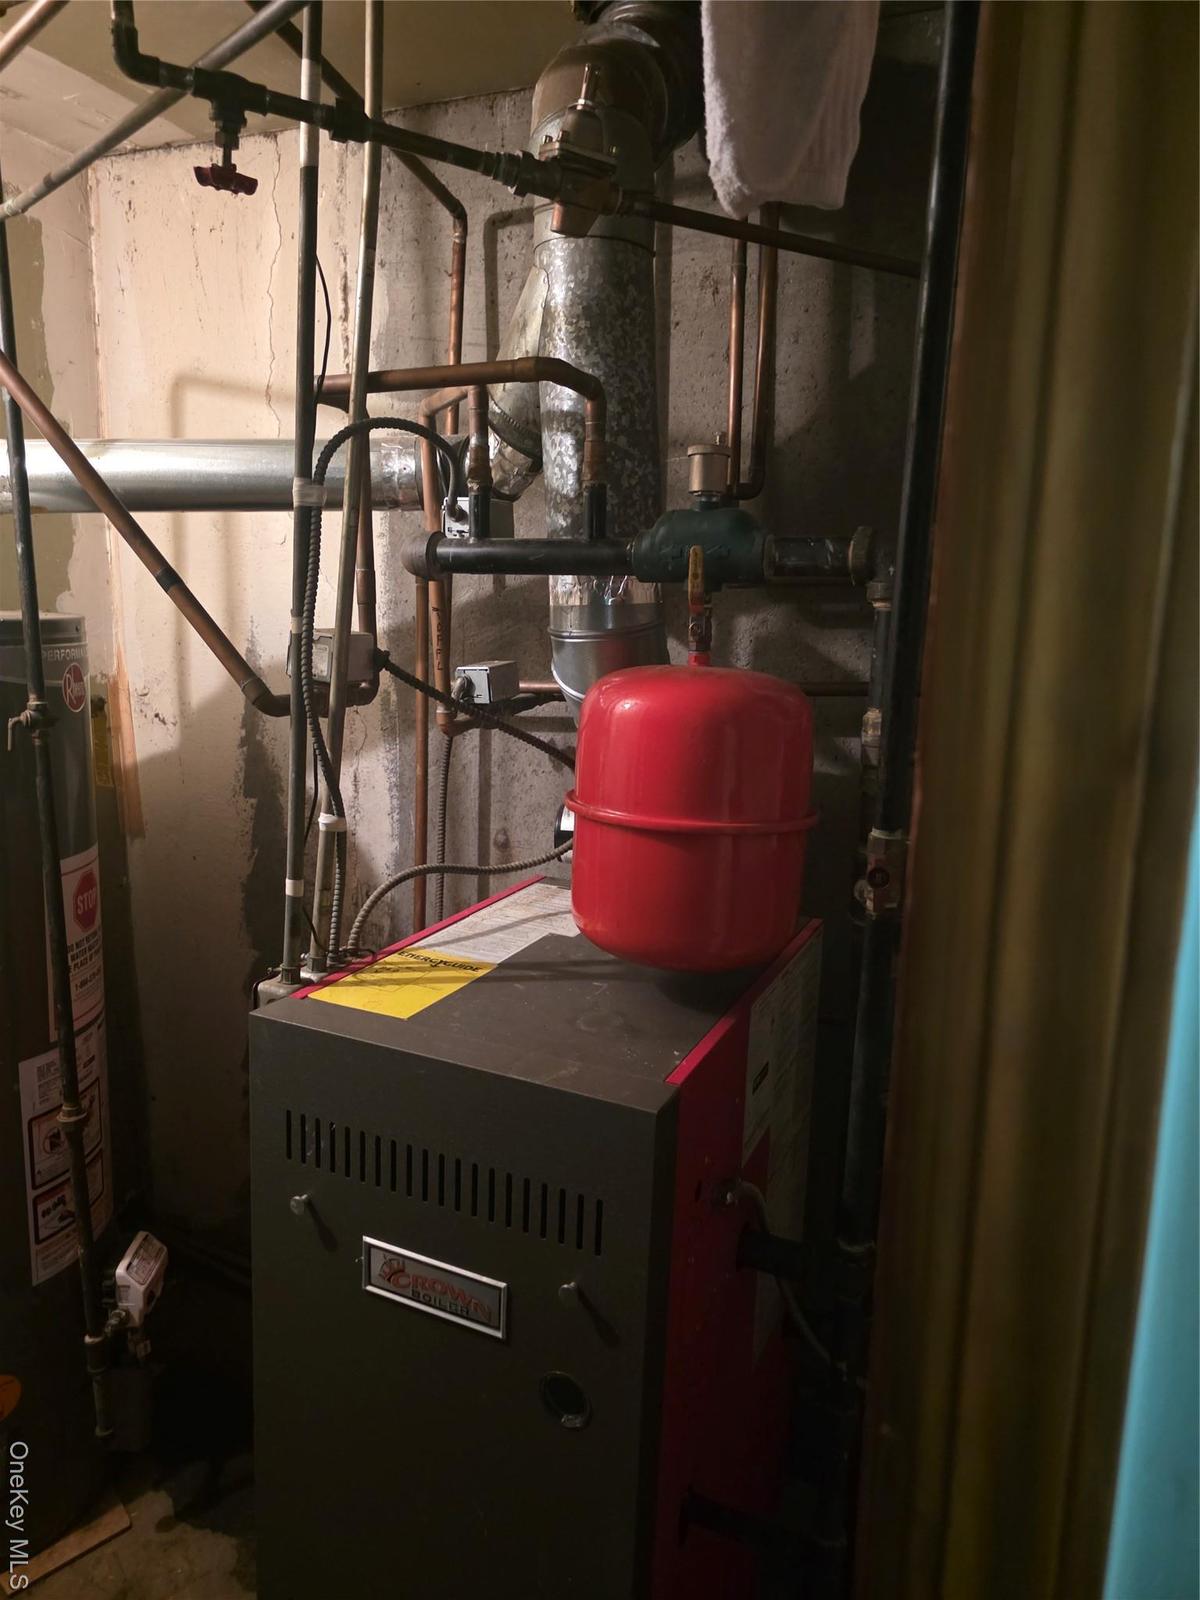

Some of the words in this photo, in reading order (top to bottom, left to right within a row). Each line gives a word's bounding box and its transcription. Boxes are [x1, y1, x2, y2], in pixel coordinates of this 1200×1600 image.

[77, 886, 97, 914] STOP
[390, 1272, 492, 1321] CROWN
[411, 1289, 469, 1316] BOILER
